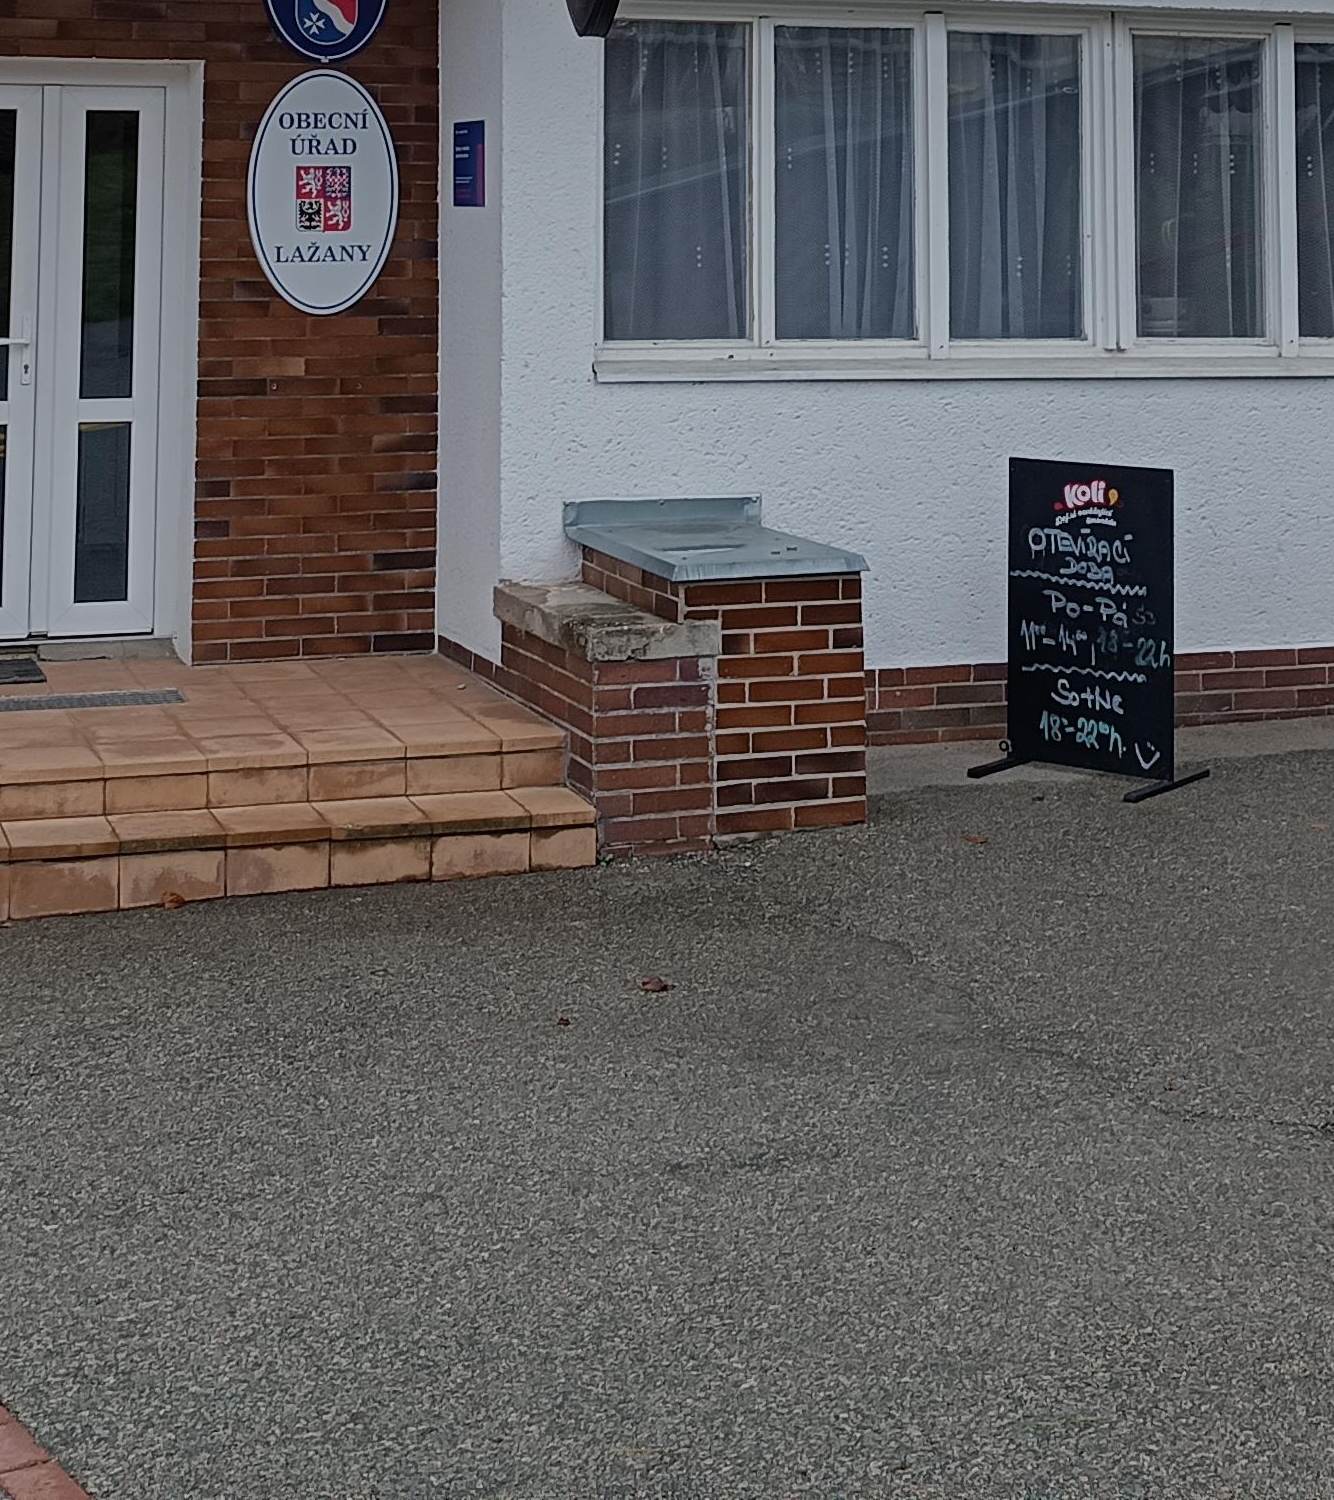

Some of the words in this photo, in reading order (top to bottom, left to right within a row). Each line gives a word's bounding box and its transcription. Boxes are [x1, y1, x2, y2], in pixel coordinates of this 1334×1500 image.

[278, 108, 370, 131] OBECNÍ
[290, 132, 357, 156] ÚŘAD
[274, 240, 372, 264] LAŽANY
[1064, 480, 1106, 509] Koli
